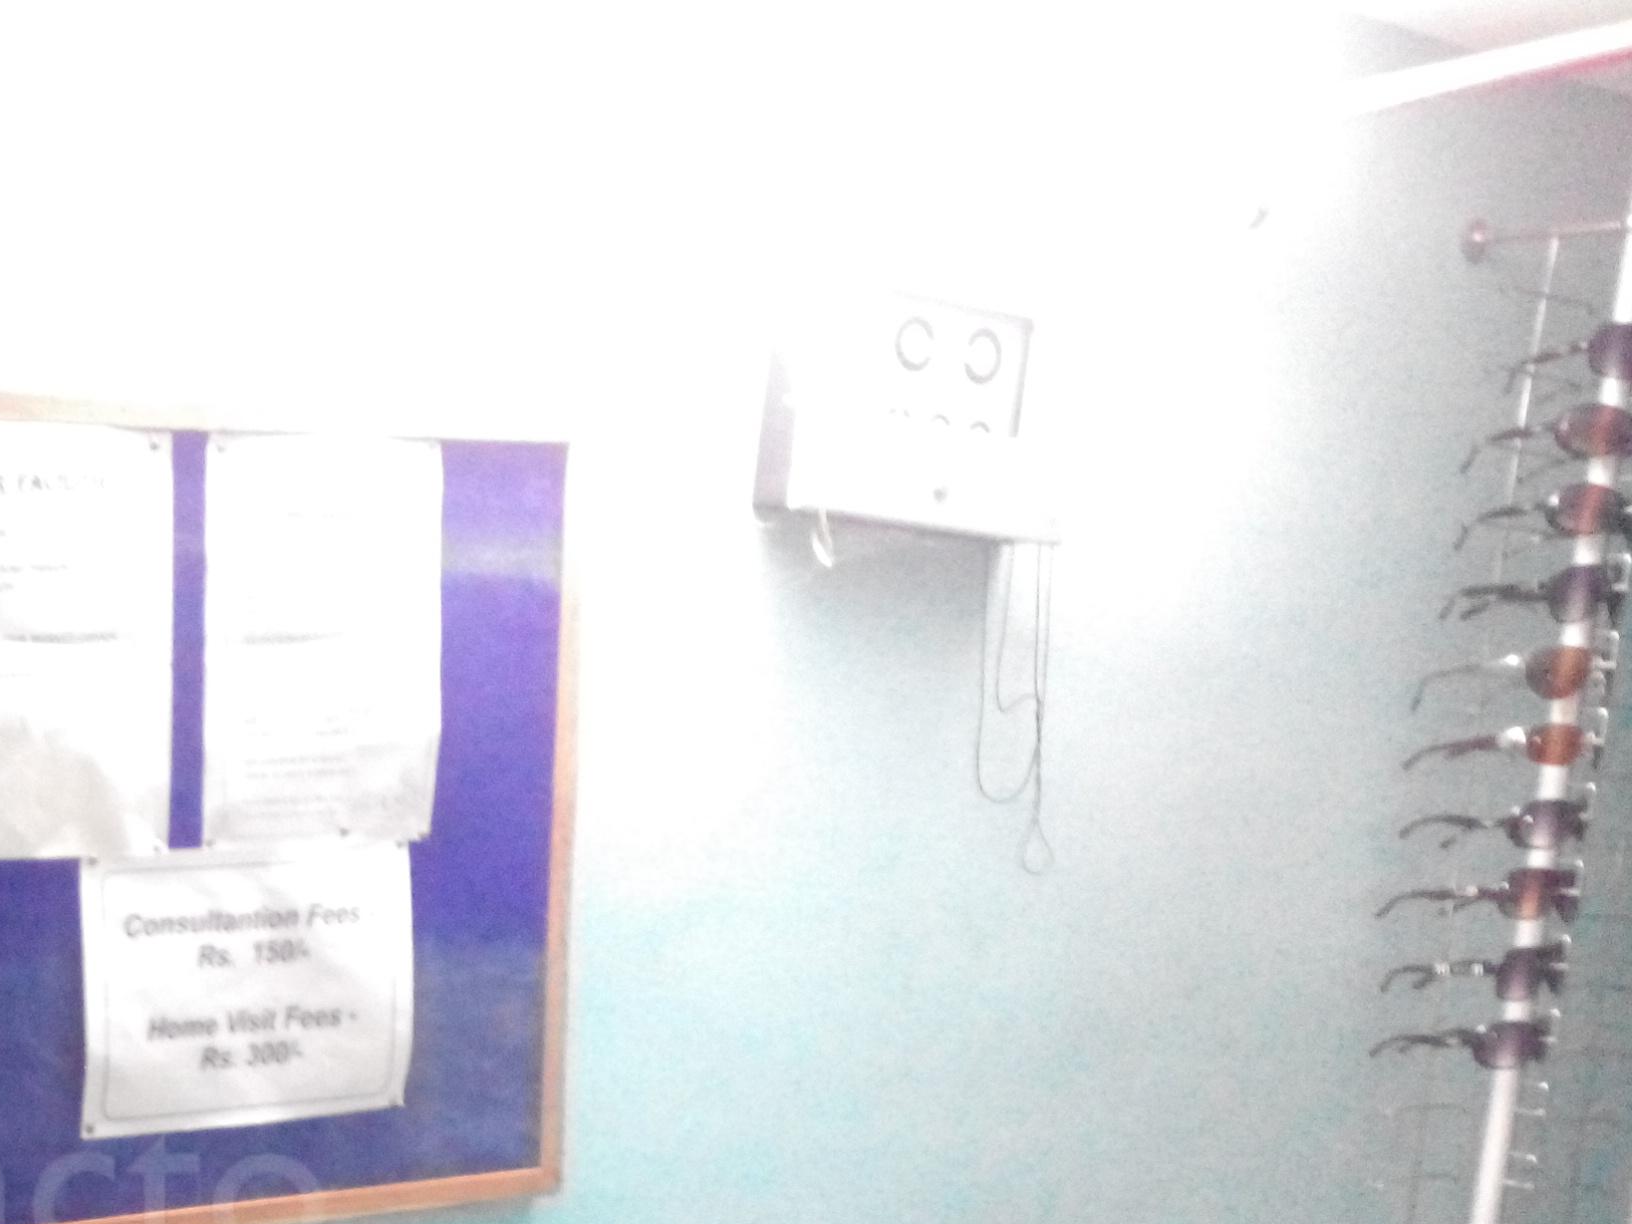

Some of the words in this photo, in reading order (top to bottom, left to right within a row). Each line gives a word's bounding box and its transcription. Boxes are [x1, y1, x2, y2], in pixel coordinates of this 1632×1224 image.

[306, 902, 361, 928] Fees
[147, 1015, 218, 1041] Home
[225, 1007, 276, 1034] Visit
[285, 1004, 343, 1031] Fees
